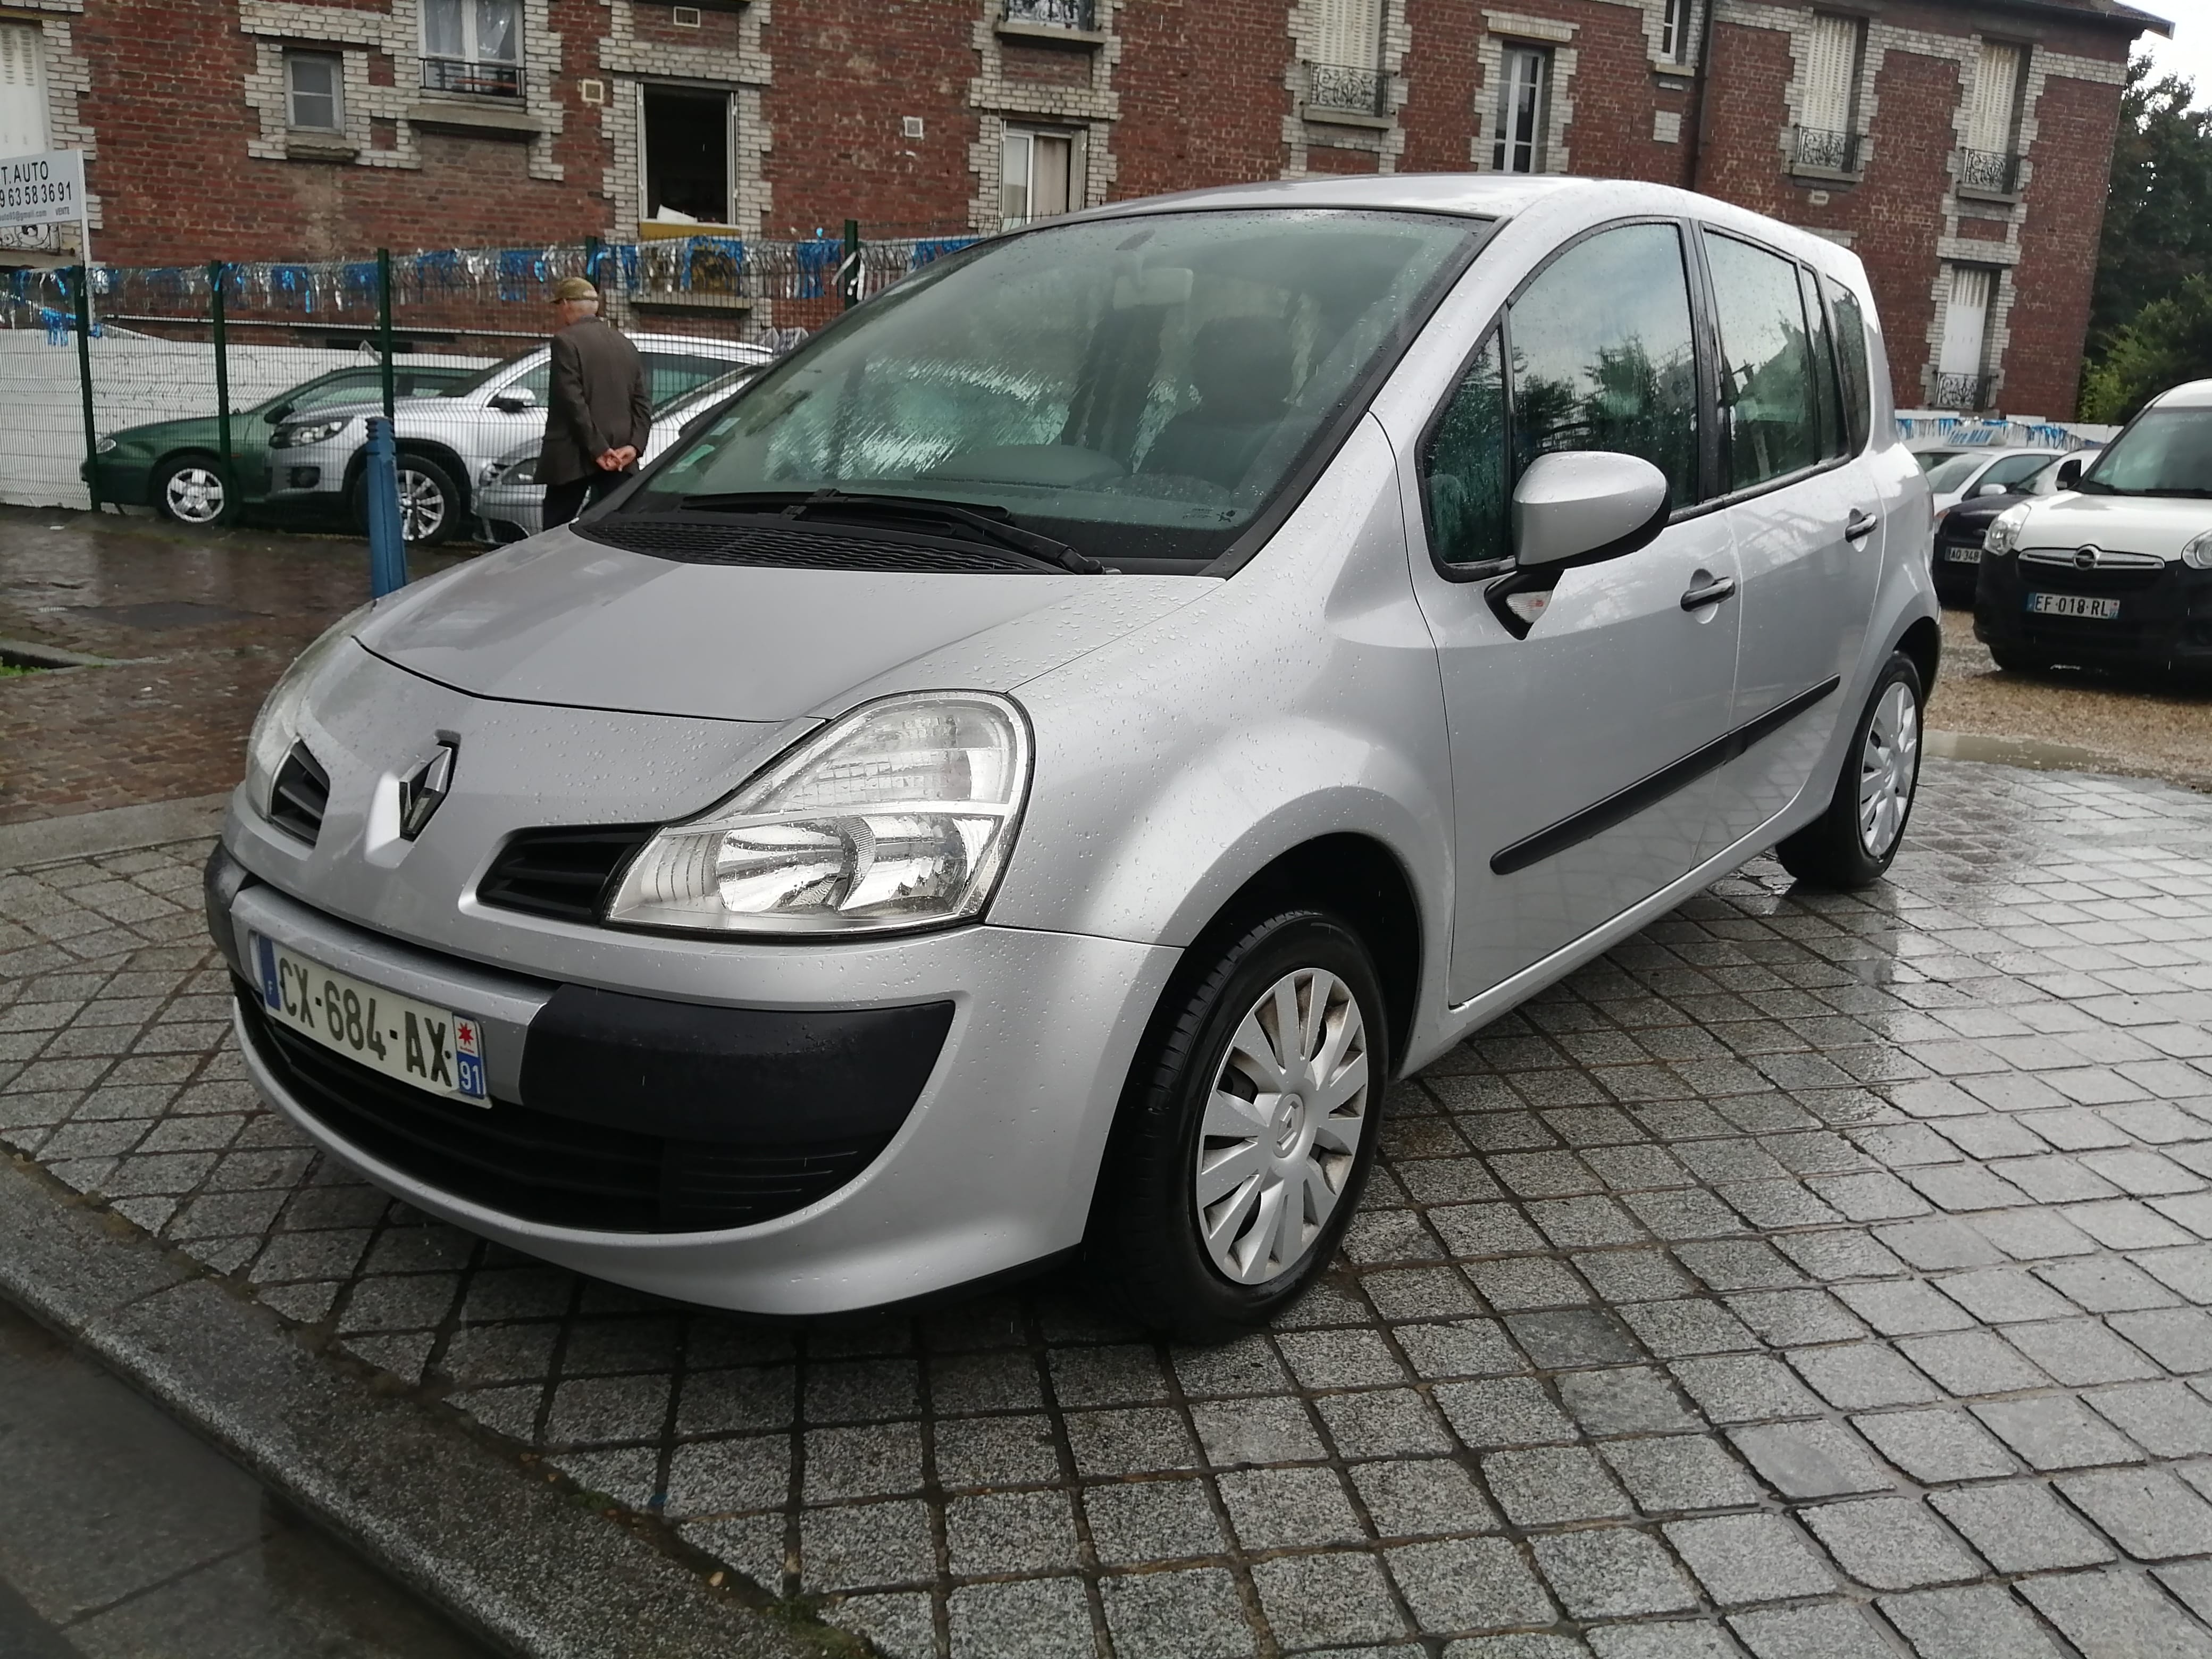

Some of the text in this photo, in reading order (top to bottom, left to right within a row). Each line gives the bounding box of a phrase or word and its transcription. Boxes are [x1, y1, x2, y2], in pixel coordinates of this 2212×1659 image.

[55, 206, 70, 216] VENTE
[279, 957, 452, 1087] CX-684-AX
[460, 1061, 481, 1095] 91
